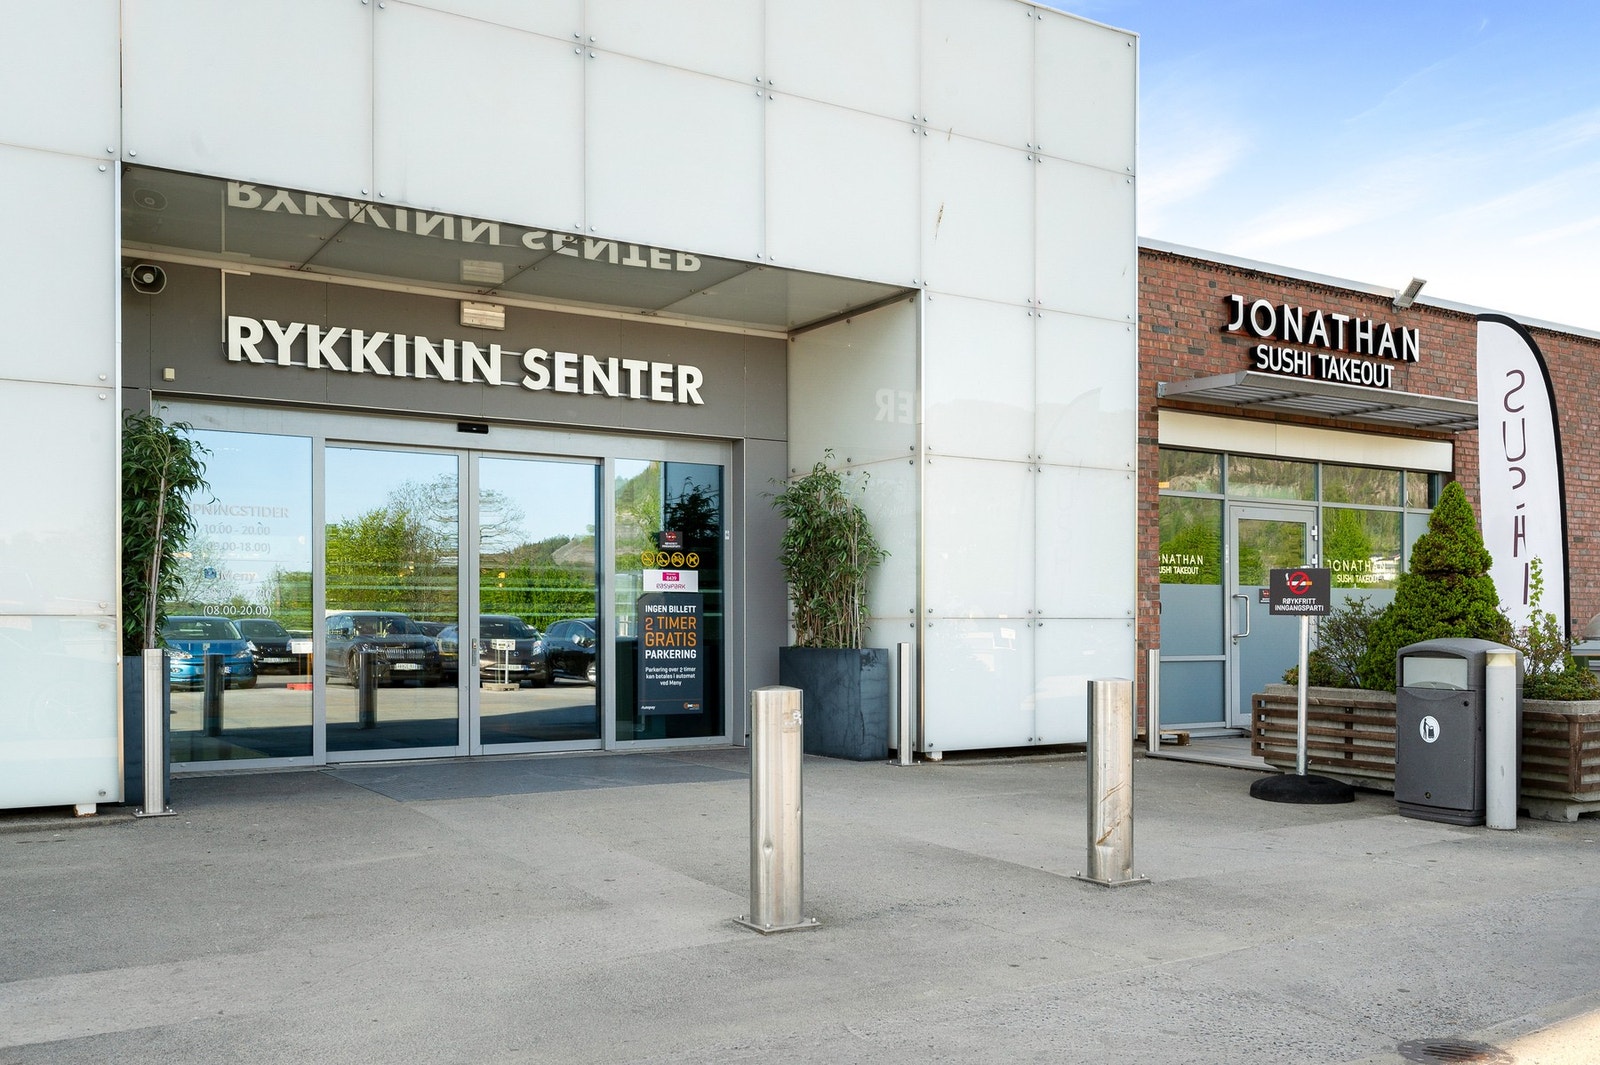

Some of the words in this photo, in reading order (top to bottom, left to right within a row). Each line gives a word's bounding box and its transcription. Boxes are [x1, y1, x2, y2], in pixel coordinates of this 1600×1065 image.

[1228, 294, 1420, 362] JONATHAN
[227, 315, 501, 385] RYKKINN
[522, 348, 705, 405] SENTER
[1256, 344, 1312, 376] SUSHI
[1318, 354, 1395, 388] TAKEOUT
[192, 503, 289, 518] PNINGSTIDER
[1159, 553, 1204, 565] NATHAN
[1173, 566, 1199, 575] TAKEOUT
[1336, 574, 1354, 583] SUSHI
[1282, 597, 1316, 605] RØYKFRITT
[203, 605, 272, 618] (08.00-20.00)
[645, 604, 668, 613] INGEN
[668, 605, 697, 613] BILLETT
[1274, 604, 1324, 612] INNGANGSPARTI
[645, 617, 654, 631] 2
[656, 616, 697, 630] TIMER
[645, 631, 697, 647] GRATIS
[645, 649, 697, 659] PARKERING
